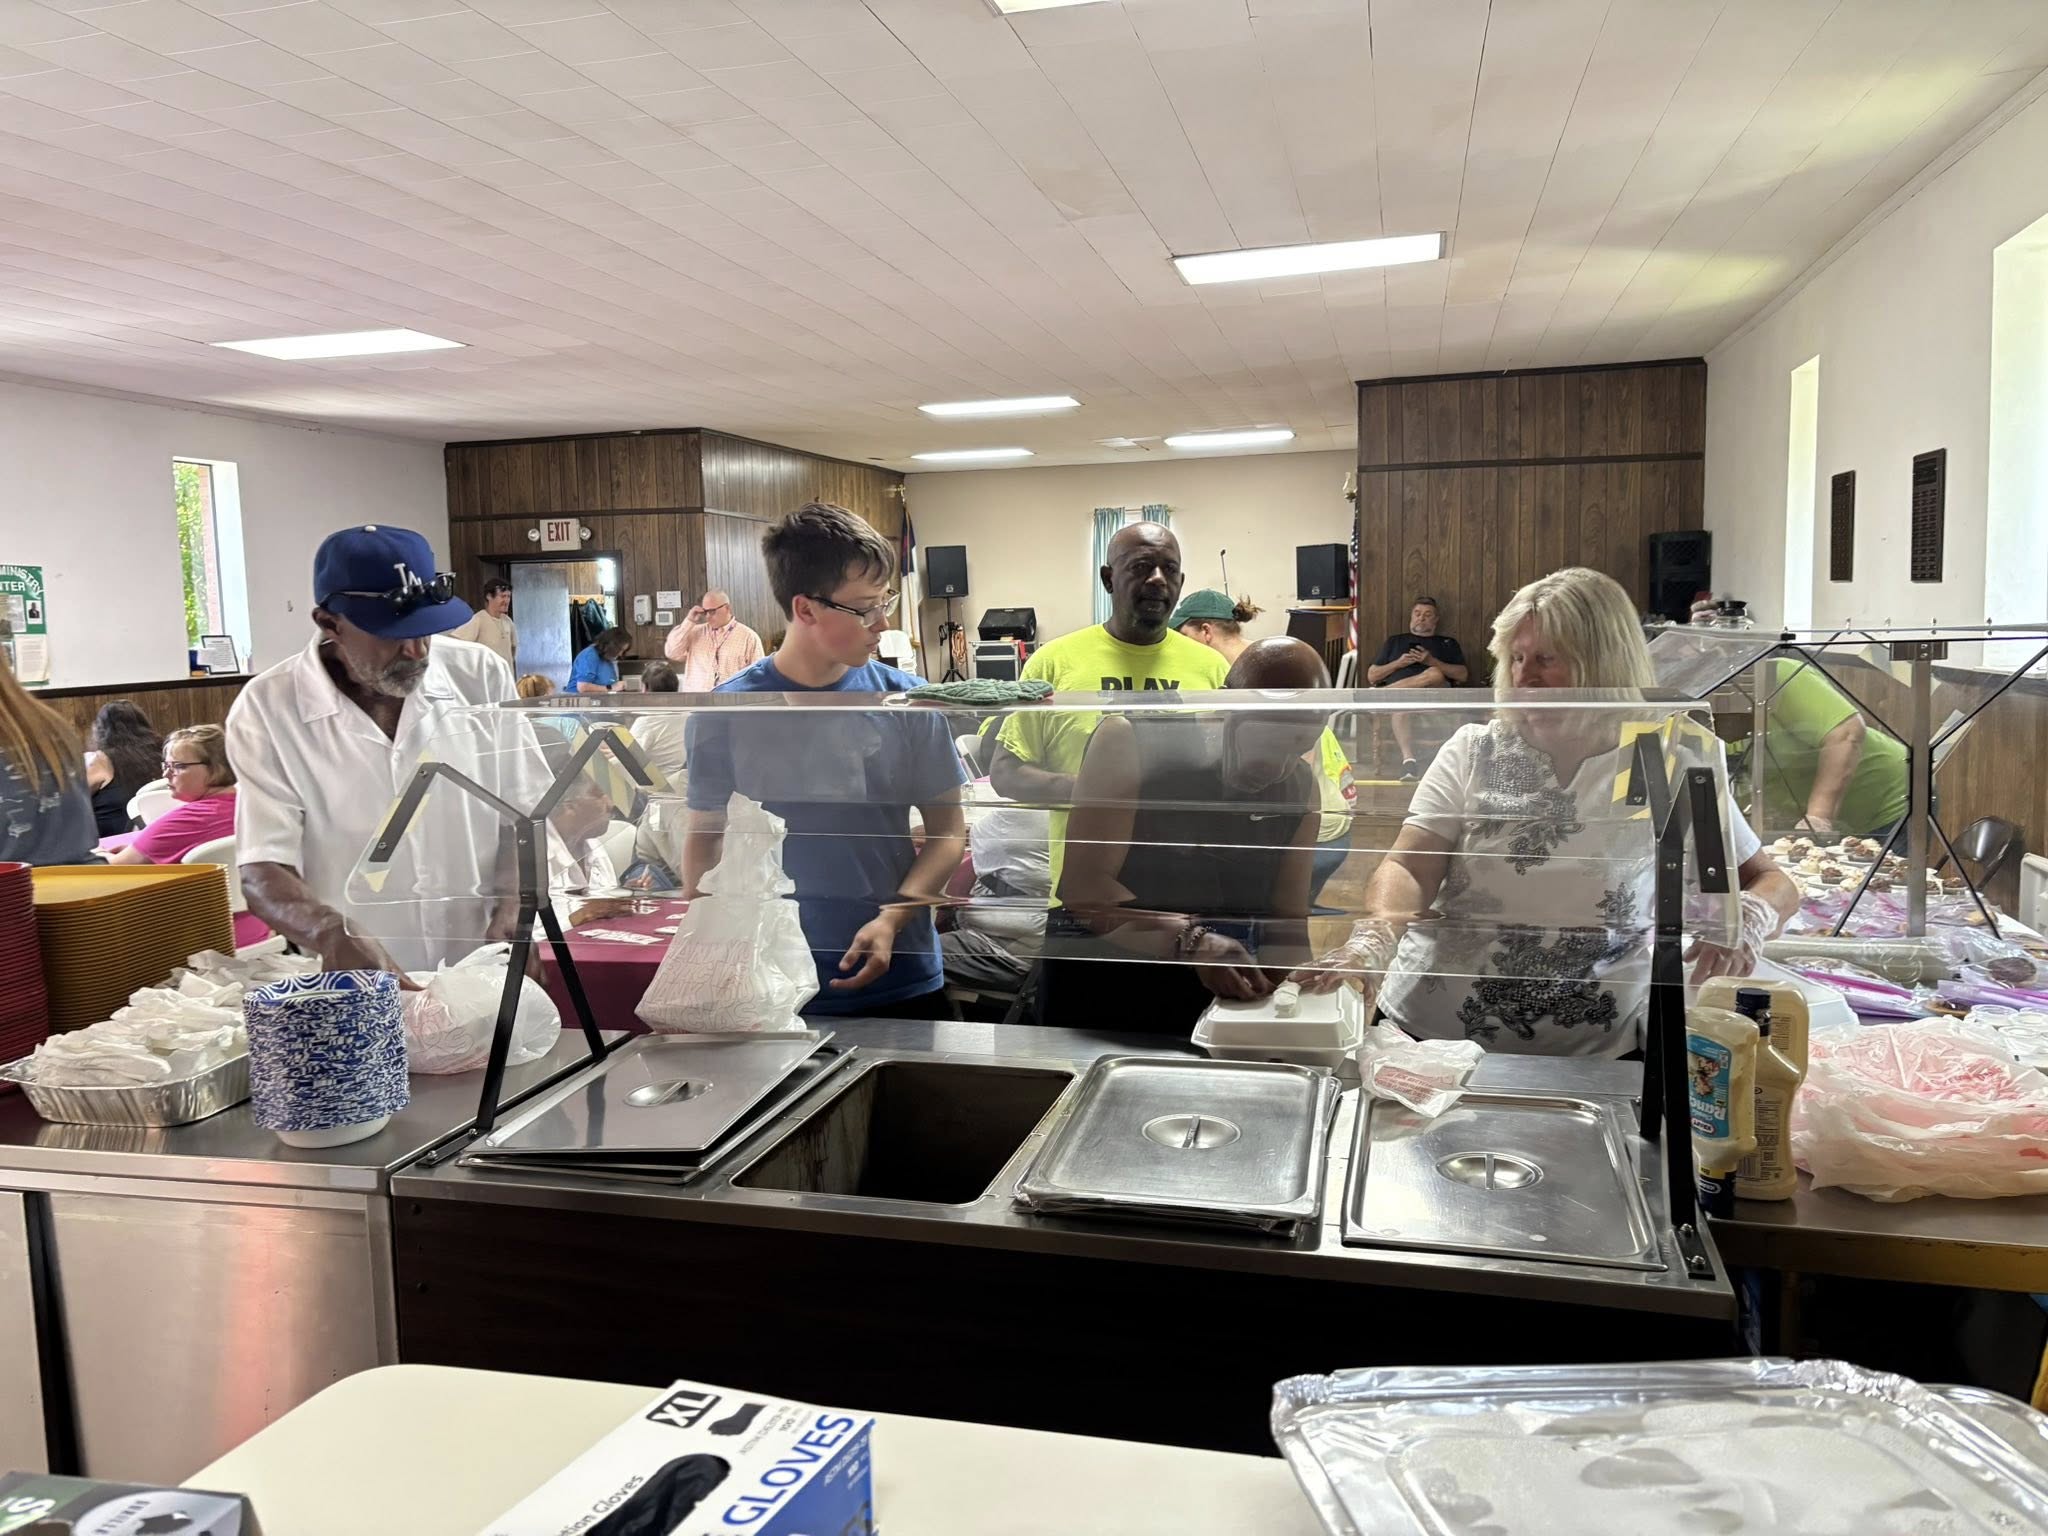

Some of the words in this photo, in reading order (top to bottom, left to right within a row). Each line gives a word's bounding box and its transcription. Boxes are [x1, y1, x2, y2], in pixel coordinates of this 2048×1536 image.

[547, 521, 571, 542] EXIT
[650, 1393, 717, 1427] XL
[722, 1414, 855, 1526] GLOVES
[592, 1474, 644, 1514] Gloves
